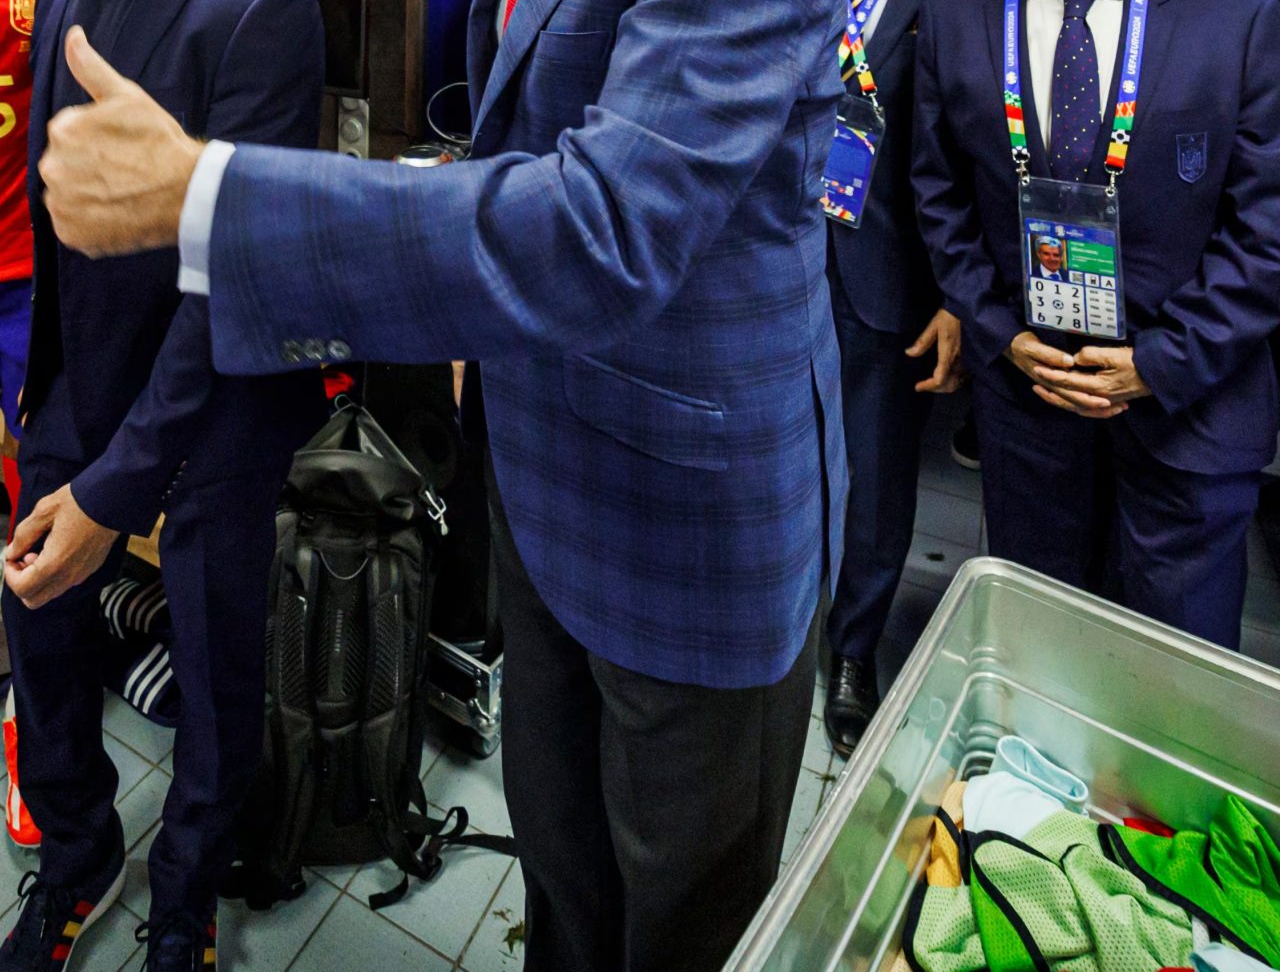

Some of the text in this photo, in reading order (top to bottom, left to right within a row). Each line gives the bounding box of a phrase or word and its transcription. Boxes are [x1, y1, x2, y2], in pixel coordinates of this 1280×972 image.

[1035, 280, 1080, 298] 0 1 2
[1105, 279, 1113, 288] A
[1037, 296, 1081, 314] 3 5
[1037, 312, 1081, 329] 6 7 8
